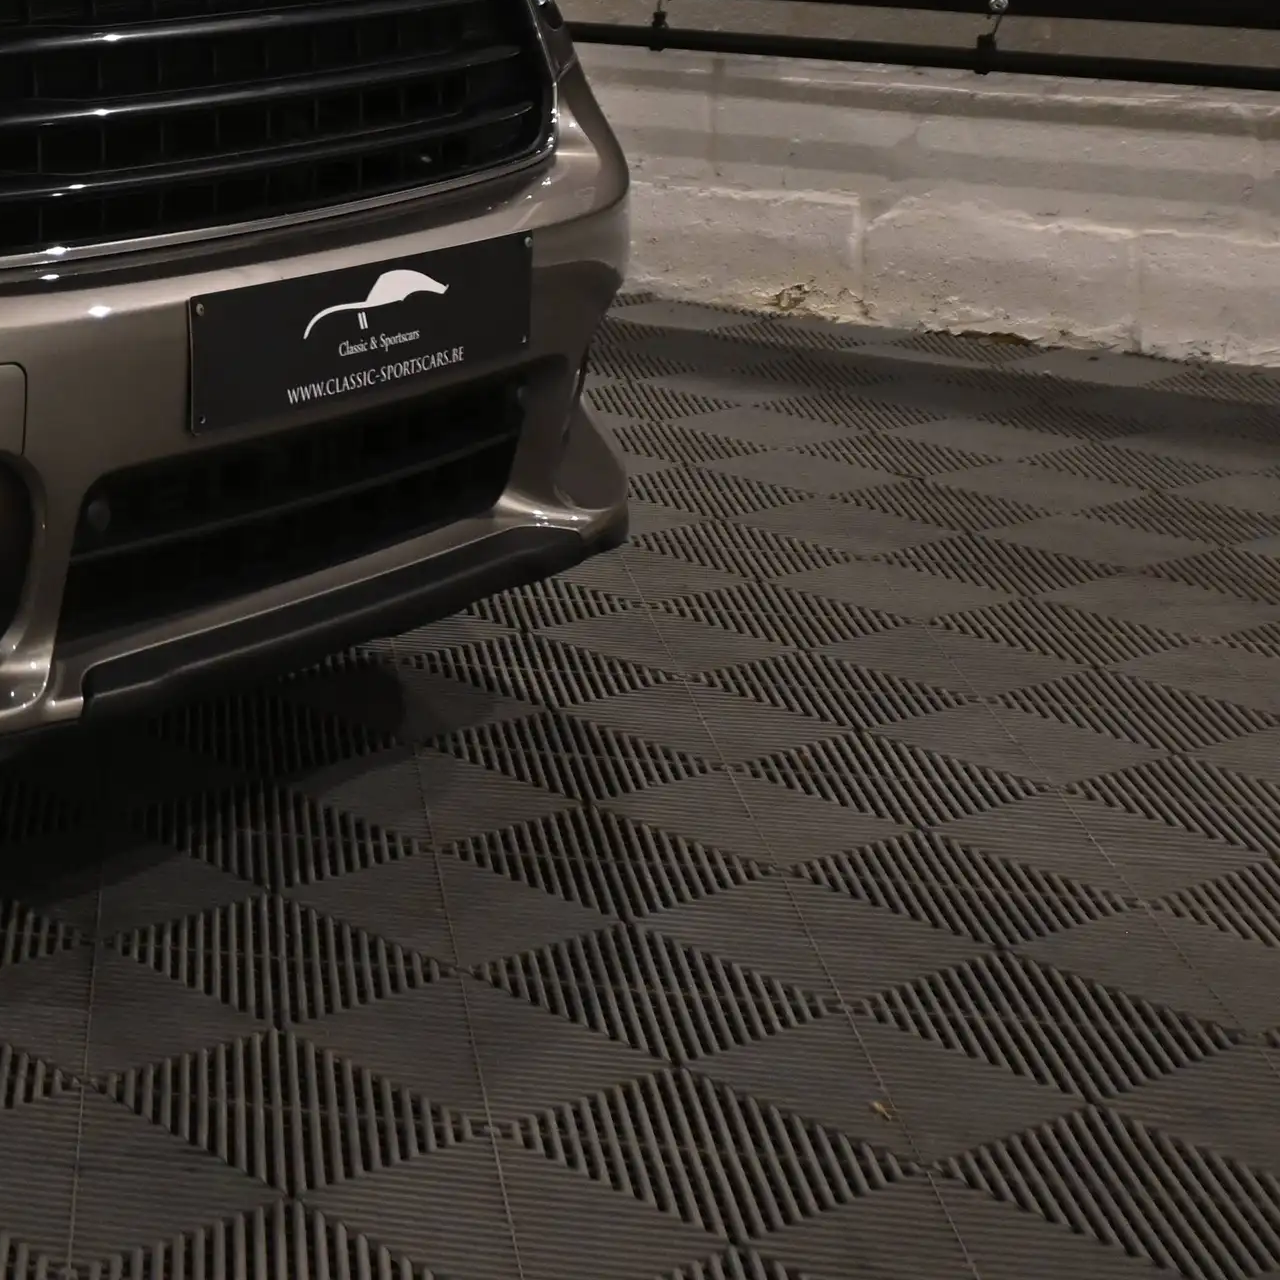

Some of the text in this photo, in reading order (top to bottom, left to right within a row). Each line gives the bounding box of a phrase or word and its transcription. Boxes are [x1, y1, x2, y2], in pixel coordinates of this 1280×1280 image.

[338, 339, 368, 357] Classic
[380, 330, 421, 352] Sportscars
[287, 346, 465, 405] WWW.CLASSIC-SPORTSCARS.BE
